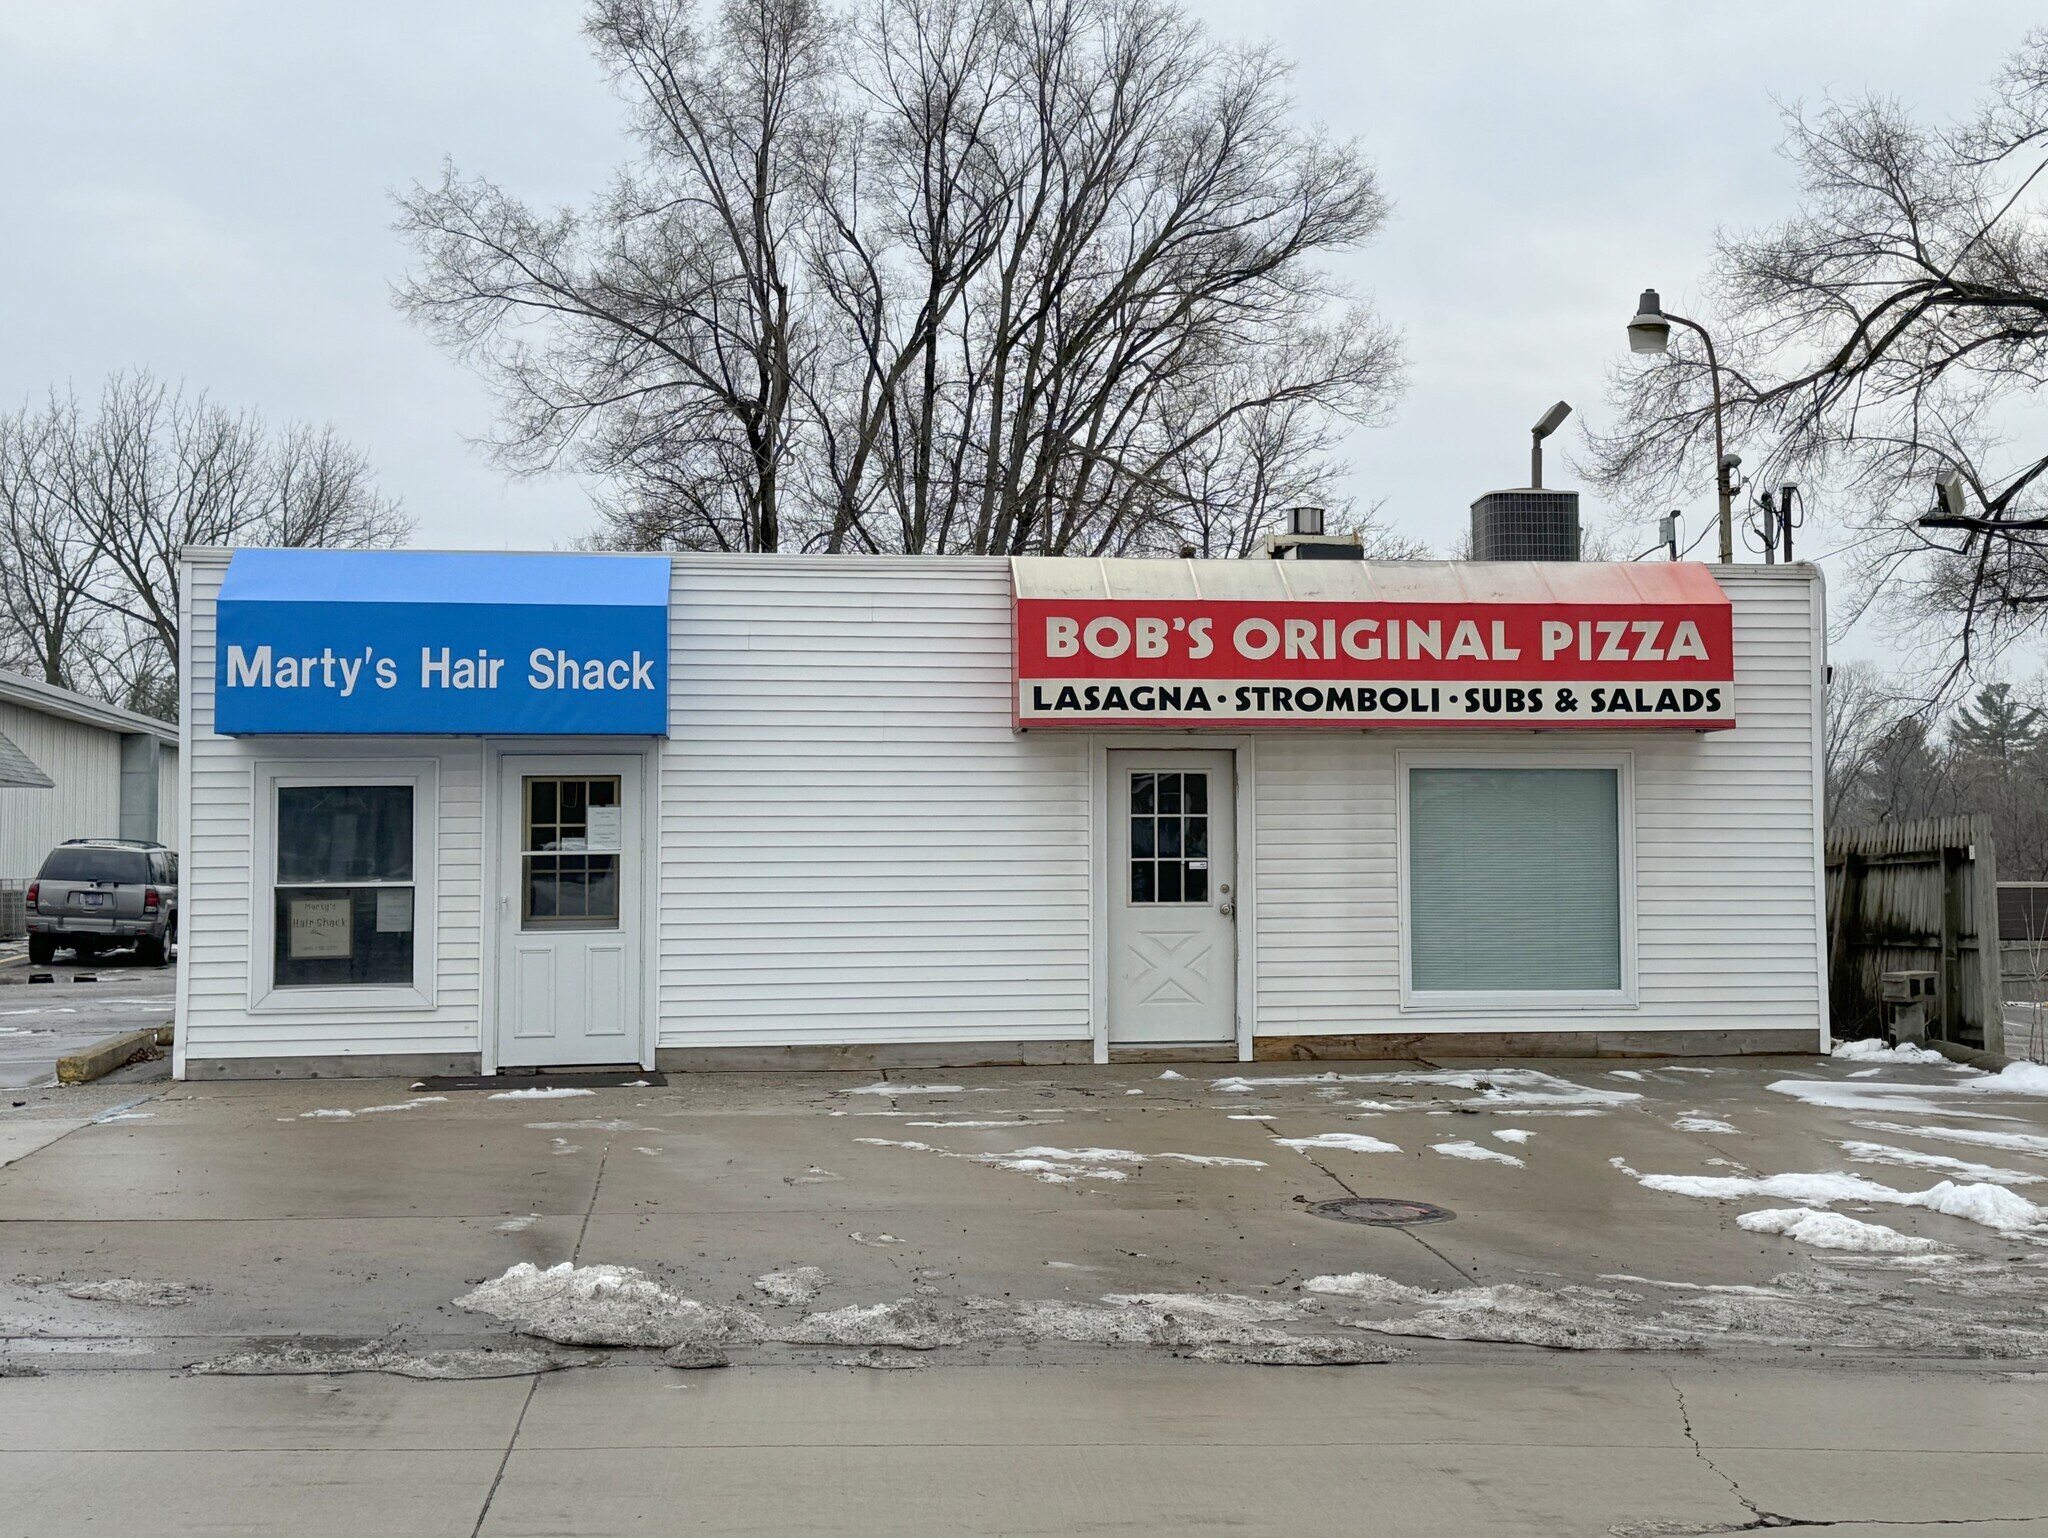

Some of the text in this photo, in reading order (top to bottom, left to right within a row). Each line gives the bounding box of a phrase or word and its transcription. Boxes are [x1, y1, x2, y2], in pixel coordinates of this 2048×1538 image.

[1046, 616, 1710, 661] BOB'S ORIGINAL PIZZA
[227, 645, 655, 697] Marty's Hair Shack
[1033, 685, 1722, 714] LASAGNA STROMBOLI SUBS & SALADS
[293, 917, 345, 928] Hair Shack
